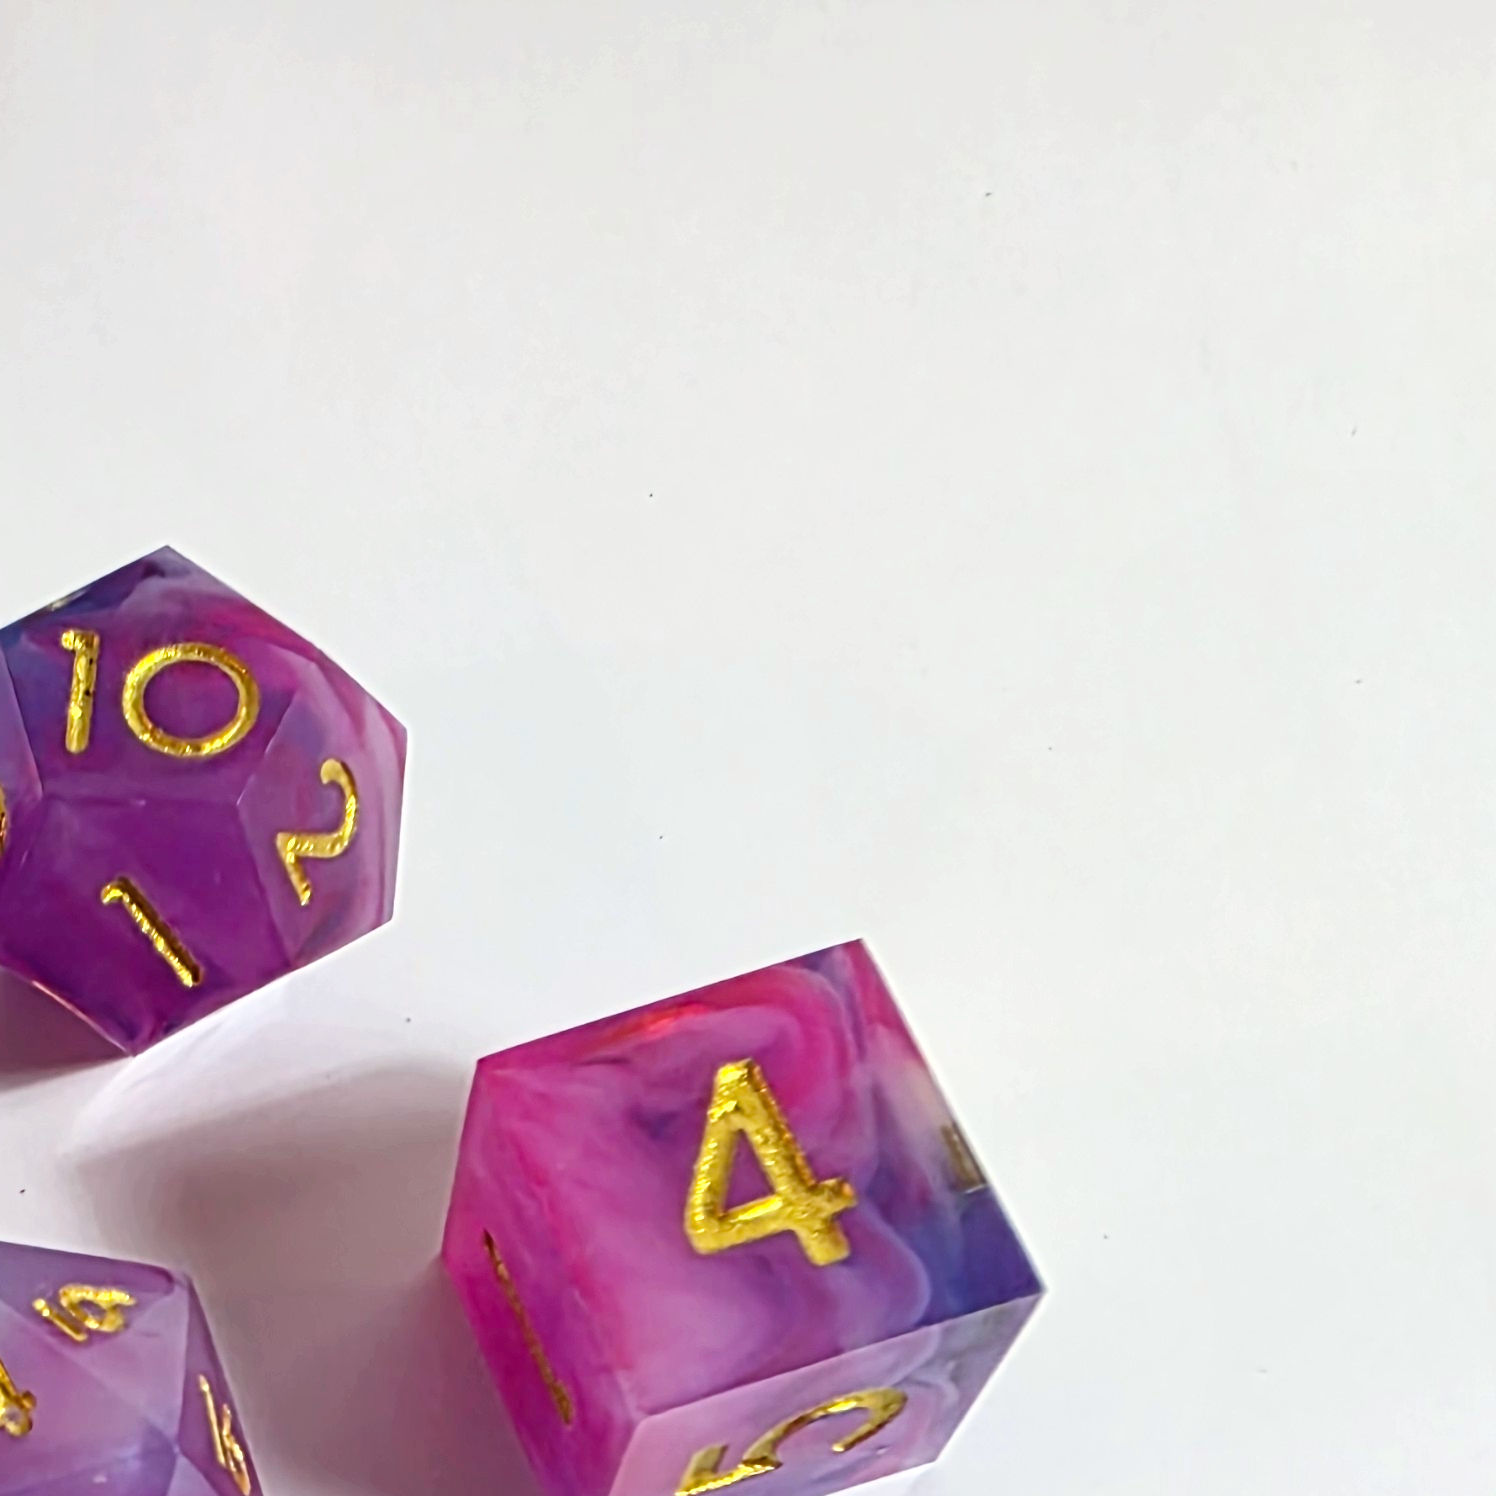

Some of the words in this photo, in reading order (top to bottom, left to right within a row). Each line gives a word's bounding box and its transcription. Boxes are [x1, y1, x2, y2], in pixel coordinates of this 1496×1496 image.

[61, 628, 259, 758] 10
[275, 757, 358, 906] 2
[101, 875, 202, 987] 1
[684, 1057, 856, 1267] 4
